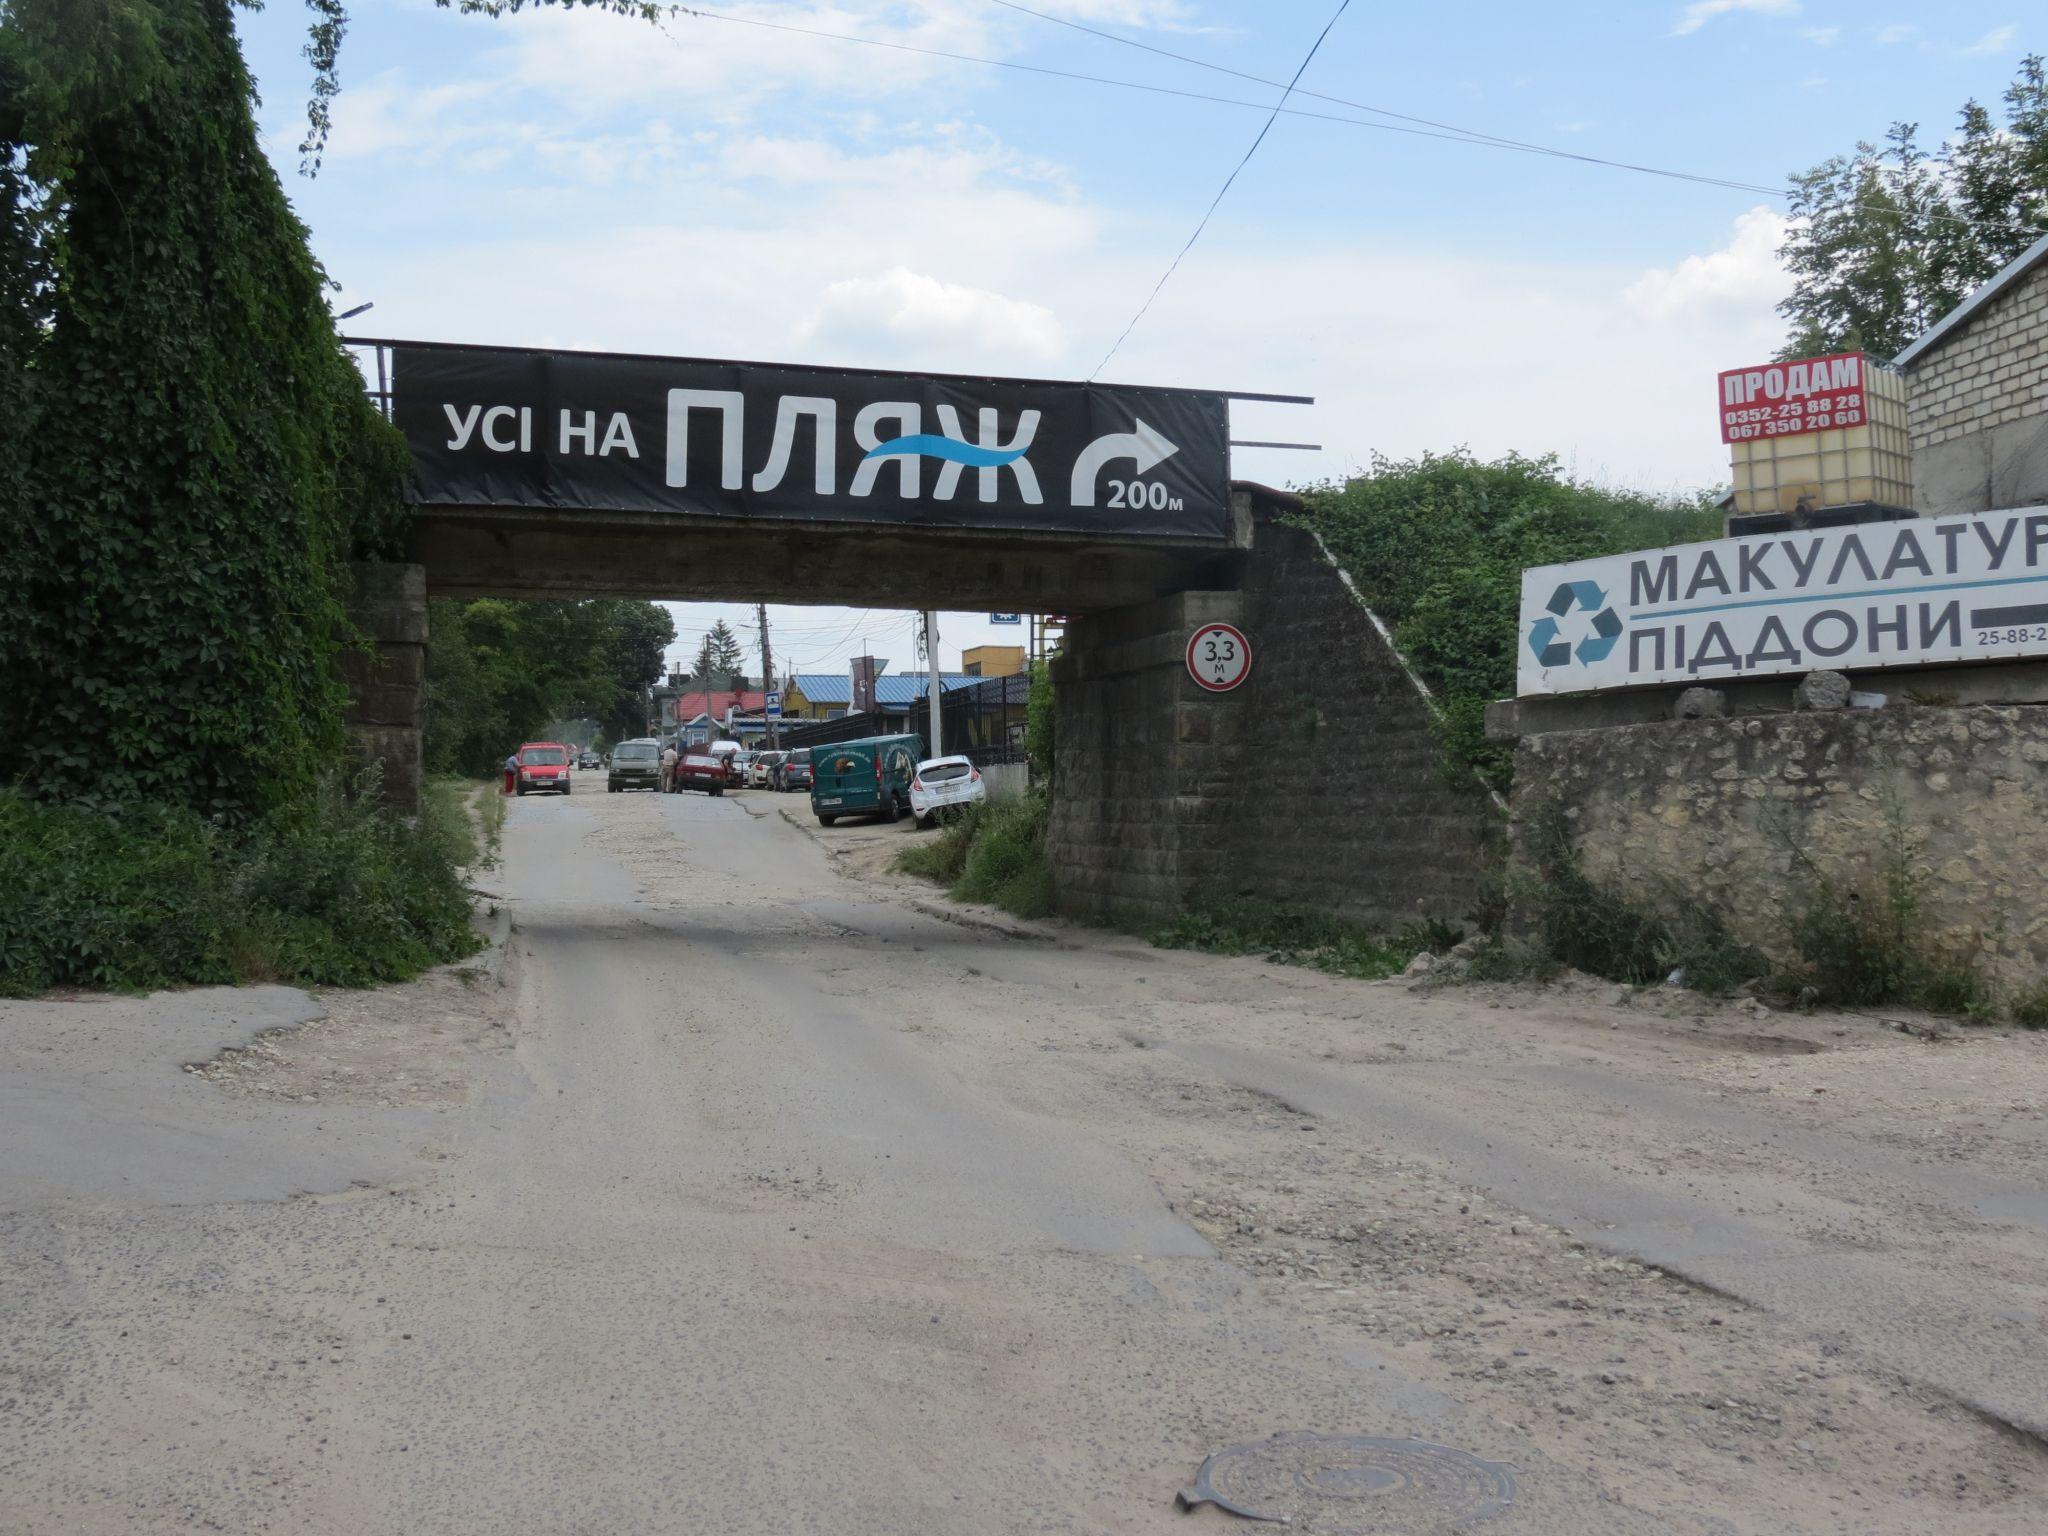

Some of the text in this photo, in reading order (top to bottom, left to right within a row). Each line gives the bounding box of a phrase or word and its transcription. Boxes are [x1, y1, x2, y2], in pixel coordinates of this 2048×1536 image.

[1724, 356, 1859, 406] ПРОДАМ
[1725, 394, 1861, 425] 0352-25 88 28
[1728, 409, 1861, 440] 067 350 20 60
[442, 388, 1044, 505] УСІ НА ПЛЯЖ
[1629, 515, 2048, 606] МАКУЛАТУР
[1204, 640, 1235, 663] 3,3
[1628, 600, 1962, 674] ПІДДОНИ
[1977, 627, 2048, 646] 25-88-2
